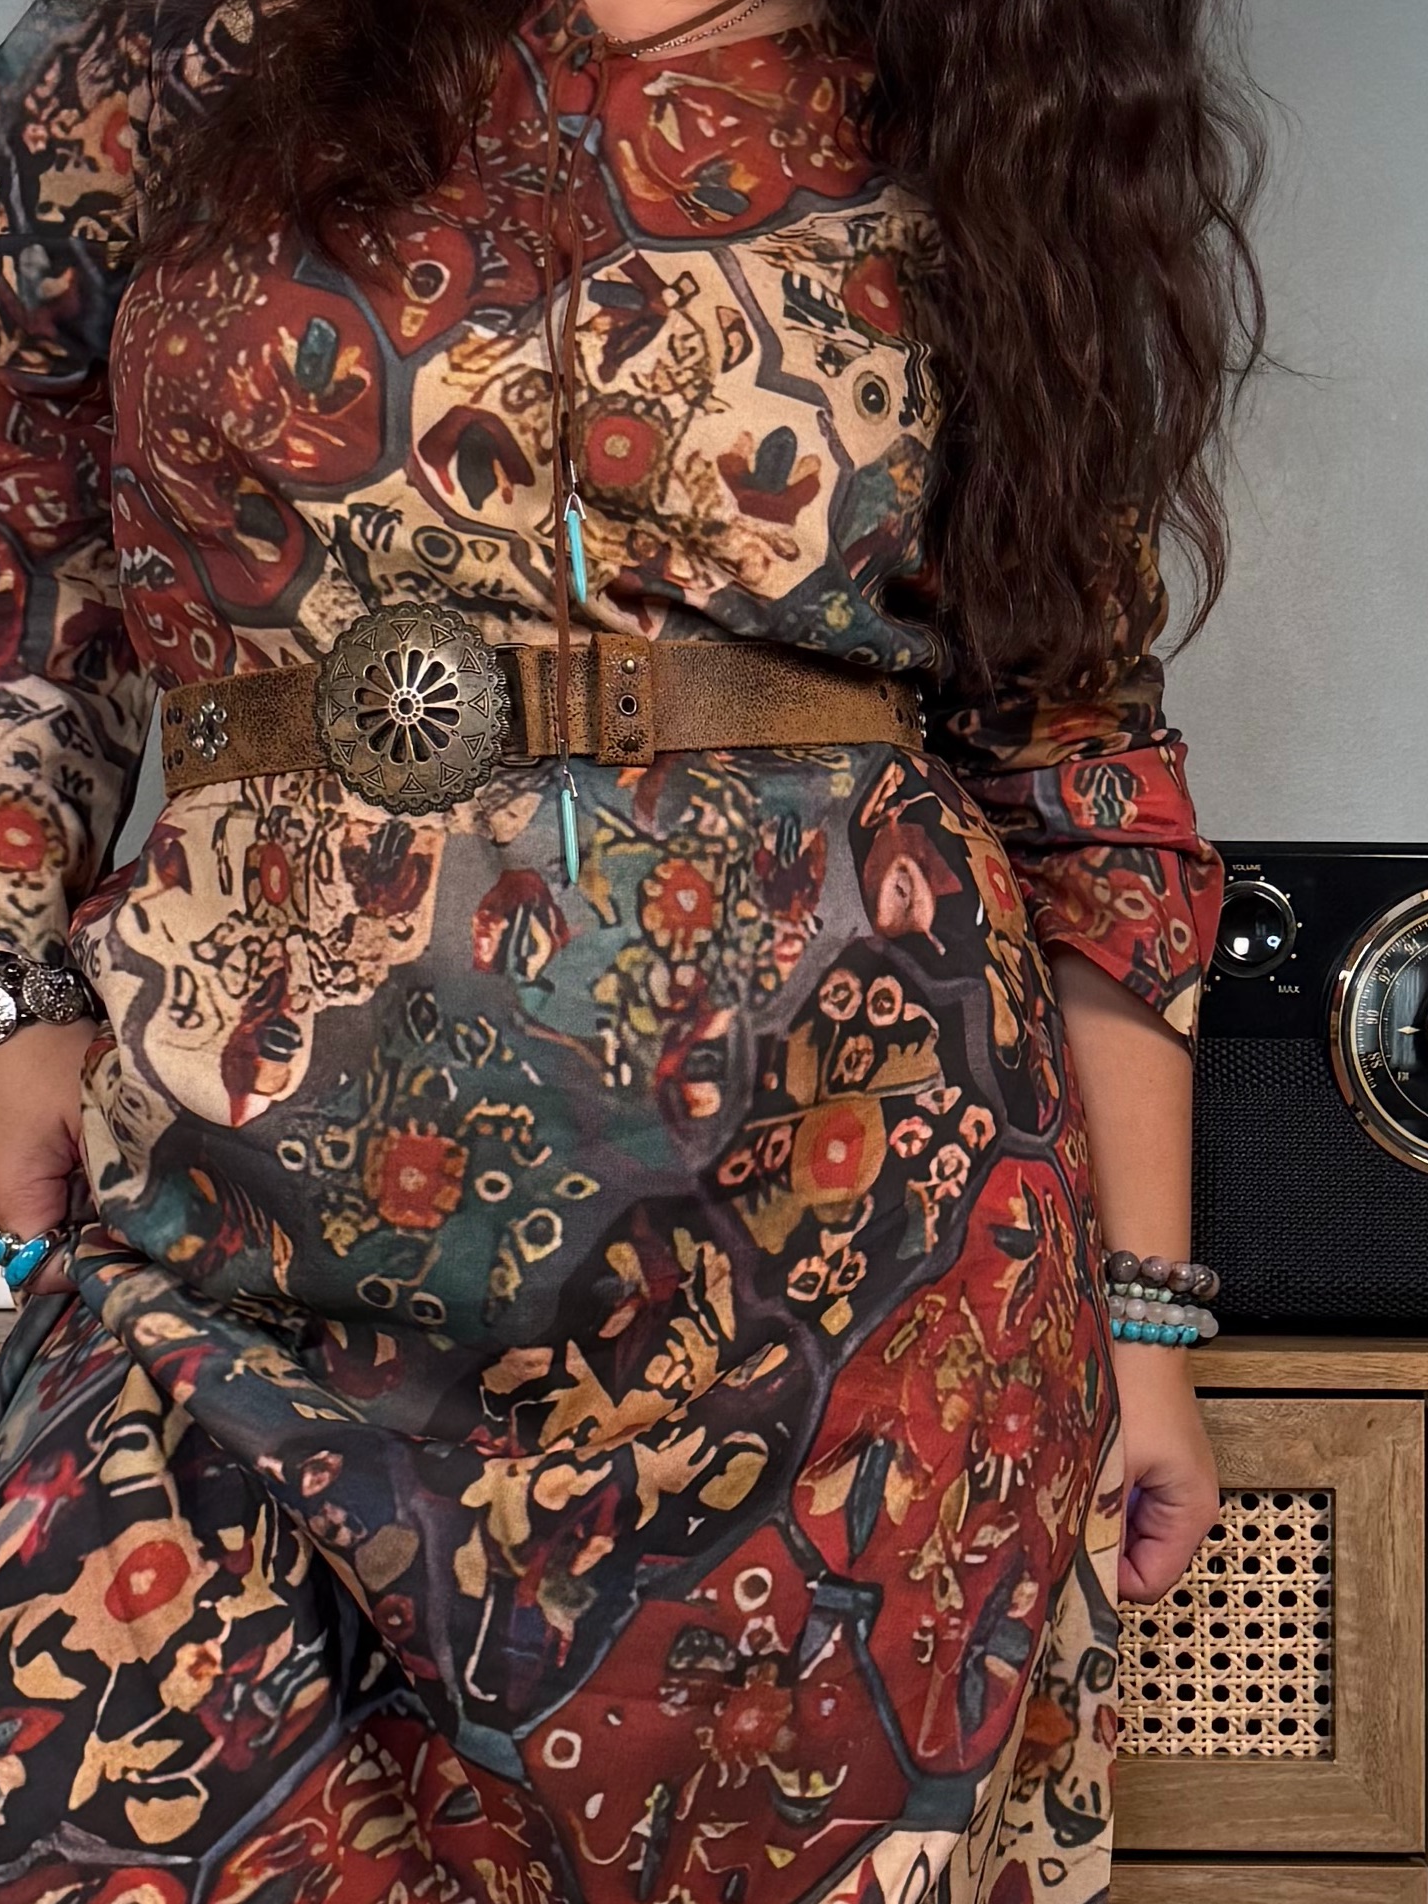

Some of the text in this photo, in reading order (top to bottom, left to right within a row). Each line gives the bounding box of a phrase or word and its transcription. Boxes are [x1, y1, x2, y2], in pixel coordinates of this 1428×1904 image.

[1232, 864, 1262, 872] VOLUME
[1378, 966, 1395, 985] 92
[1277, 985, 1301, 994] MAX
[1365, 1009, 1380, 1025] 90
[1367, 1051, 1384, 1069] 88
